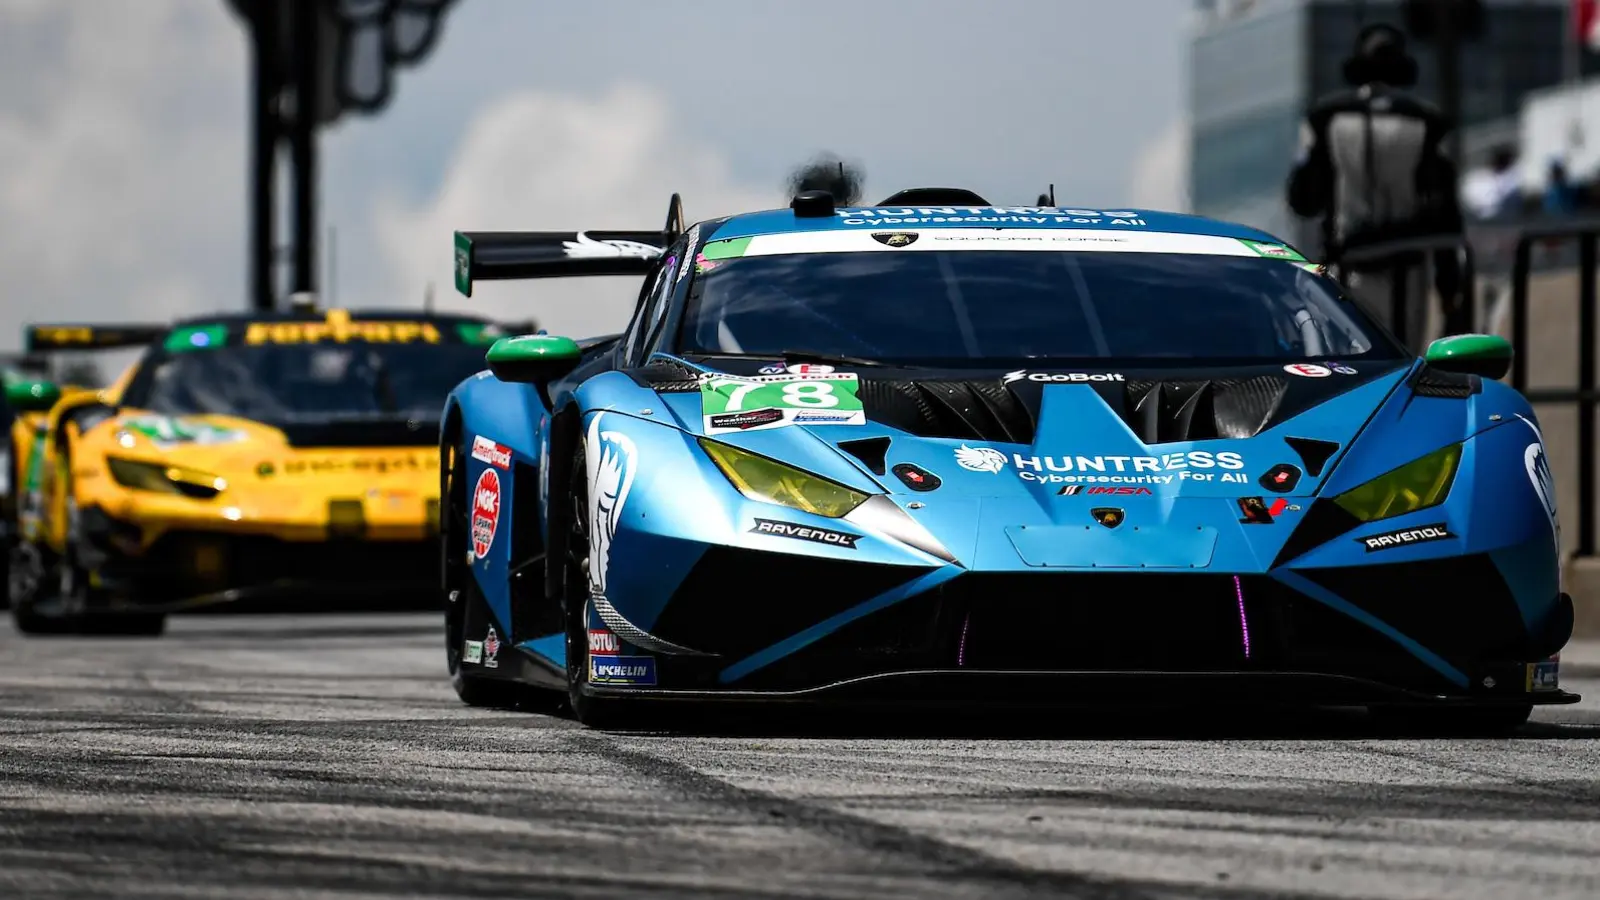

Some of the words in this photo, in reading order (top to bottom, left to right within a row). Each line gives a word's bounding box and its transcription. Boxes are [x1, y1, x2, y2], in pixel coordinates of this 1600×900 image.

[843, 215, 1048, 226] Cybersecurity
[1055, 216, 1102, 224] For
[1110, 217, 1148, 227] All
[1028, 373, 1126, 382] GoBolt
[712, 379, 840, 412] 78
[1012, 450, 1245, 473] HUNTRESS
[1018, 470, 1173, 485] Cybersecurity
[1178, 470, 1215, 482] For
[1220, 472, 1249, 484] All
[477, 488, 498, 513] NGK
[1086, 486, 1153, 496] IMSA
[757, 521, 851, 546] RAVENOL
[1365, 526, 1448, 549] RAVENOL
[598, 664, 648, 677] MICHELIN
